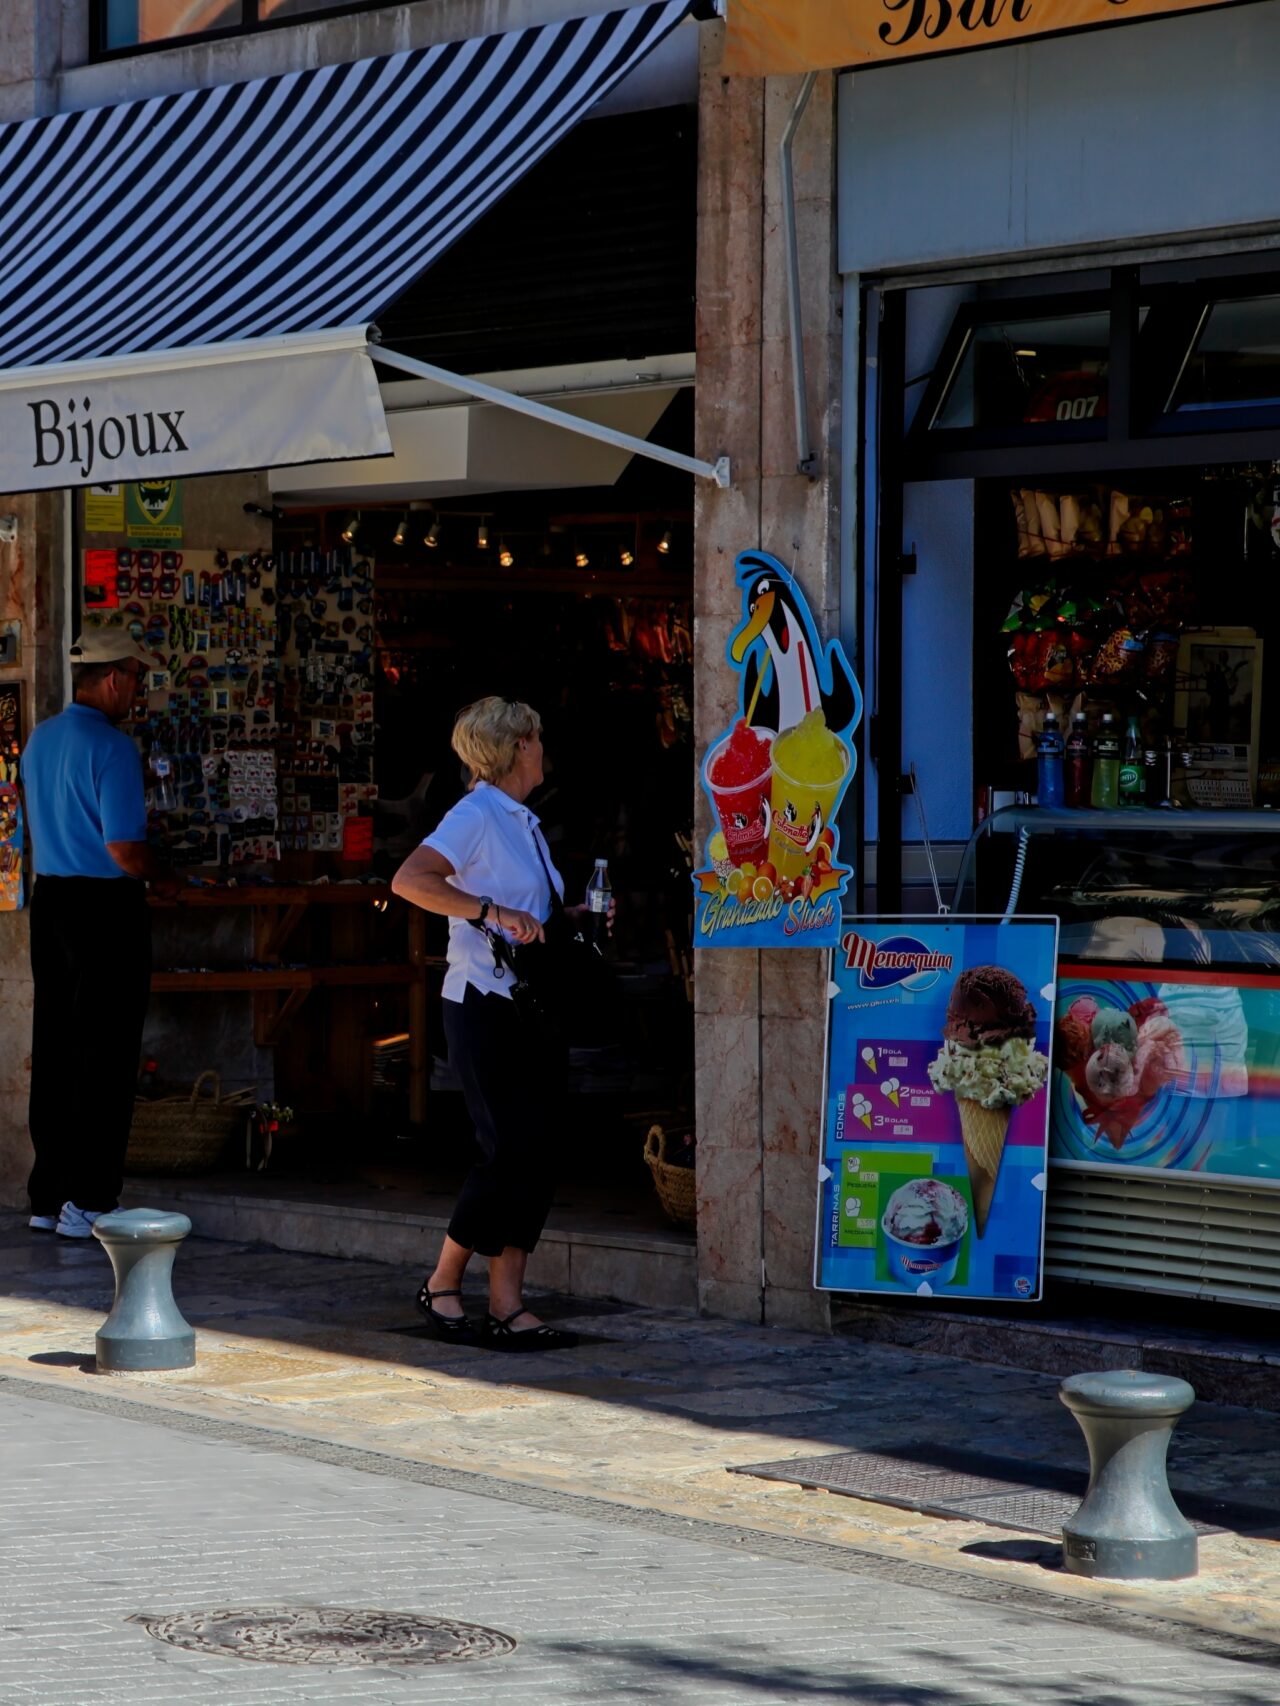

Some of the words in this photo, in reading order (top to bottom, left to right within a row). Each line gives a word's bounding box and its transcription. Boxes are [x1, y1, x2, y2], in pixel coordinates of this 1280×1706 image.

[1056, 395, 1099, 421] 007
[27, 397, 189, 478] Bijoux
[701, 890, 784, 938] Granizado
[783, 895, 835, 936] Slush
[841, 931, 953, 981] Menorquina
[899, 1086, 910, 1097] 2
[836, 1093, 846, 1140] CONOS
[874, 1115, 884, 1126] 3
[831, 1184, 841, 1248] TARRINAS
